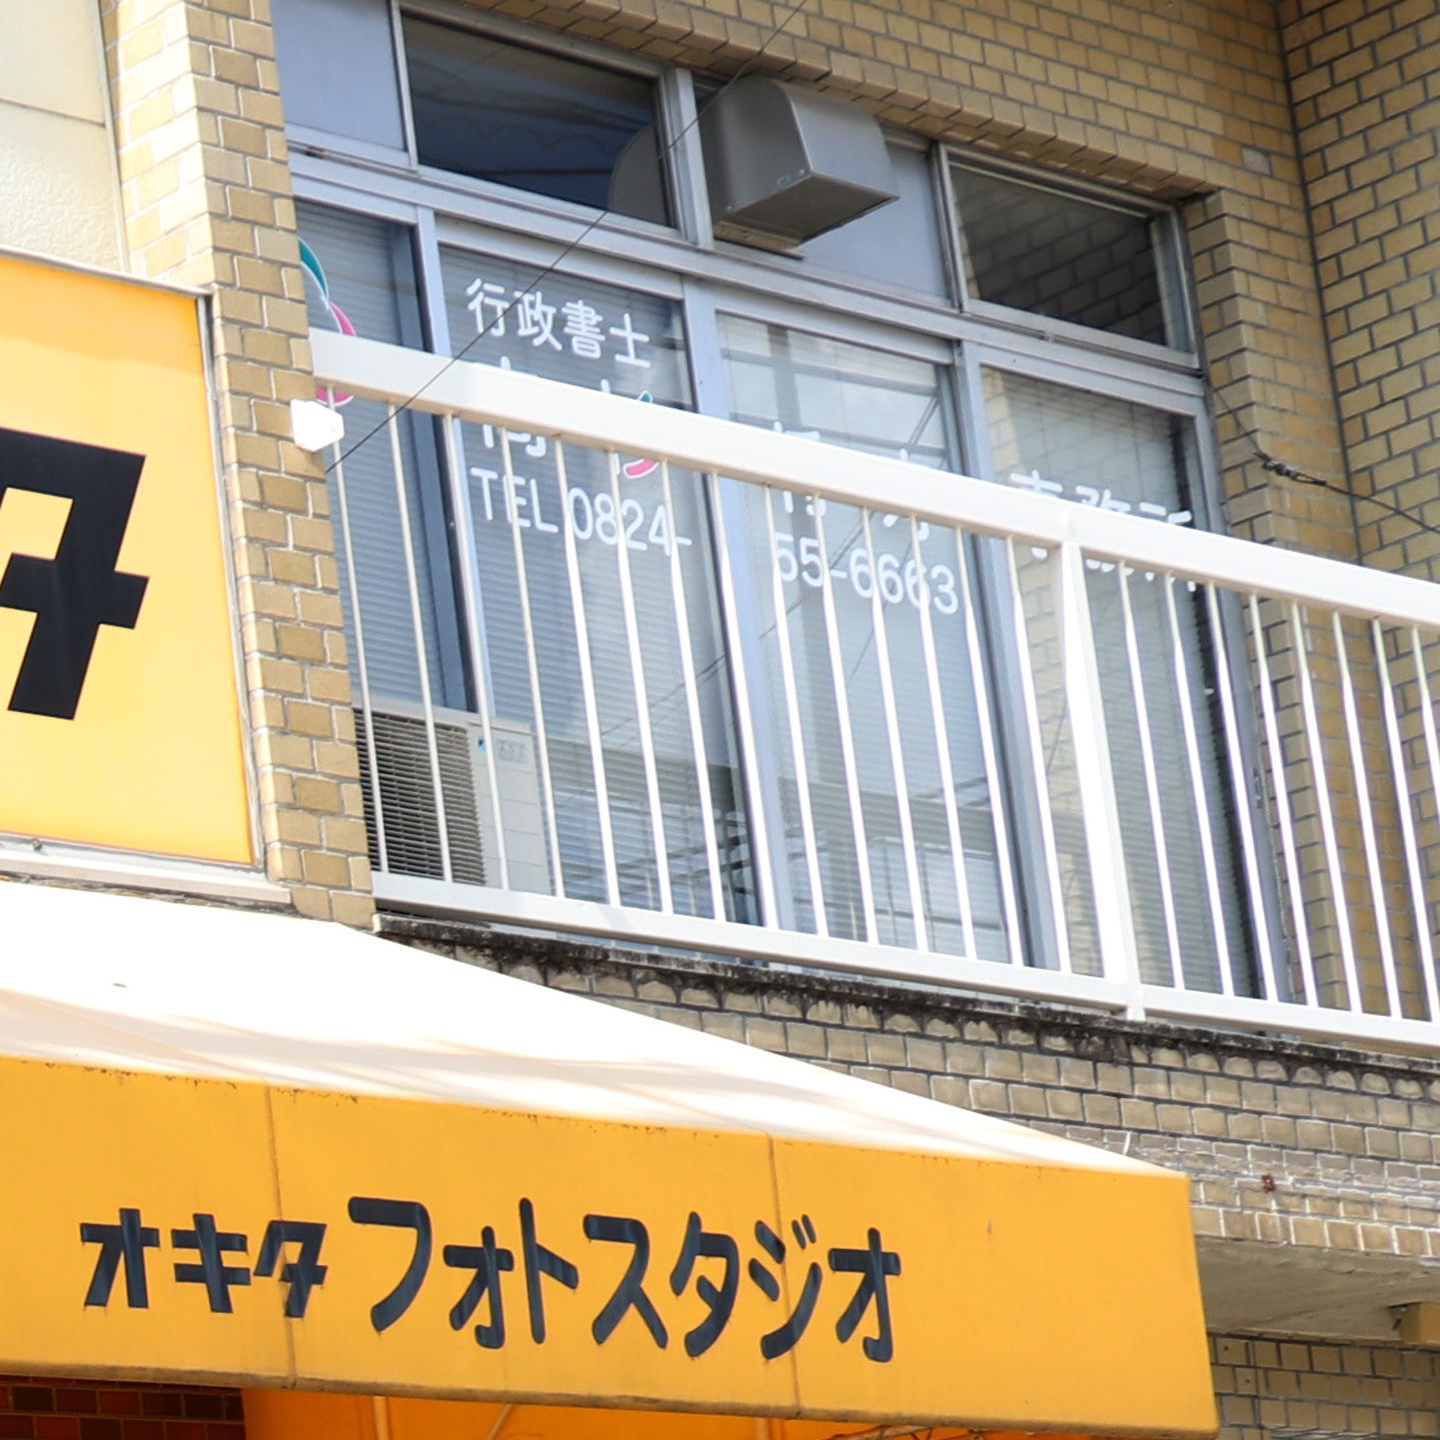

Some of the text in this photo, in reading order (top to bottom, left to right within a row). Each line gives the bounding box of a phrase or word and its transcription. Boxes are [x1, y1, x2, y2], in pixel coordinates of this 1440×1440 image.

[466, 278, 650, 368] 行政書士
[79, 1196, 902, 1364] オキタ フォトスタジオ
